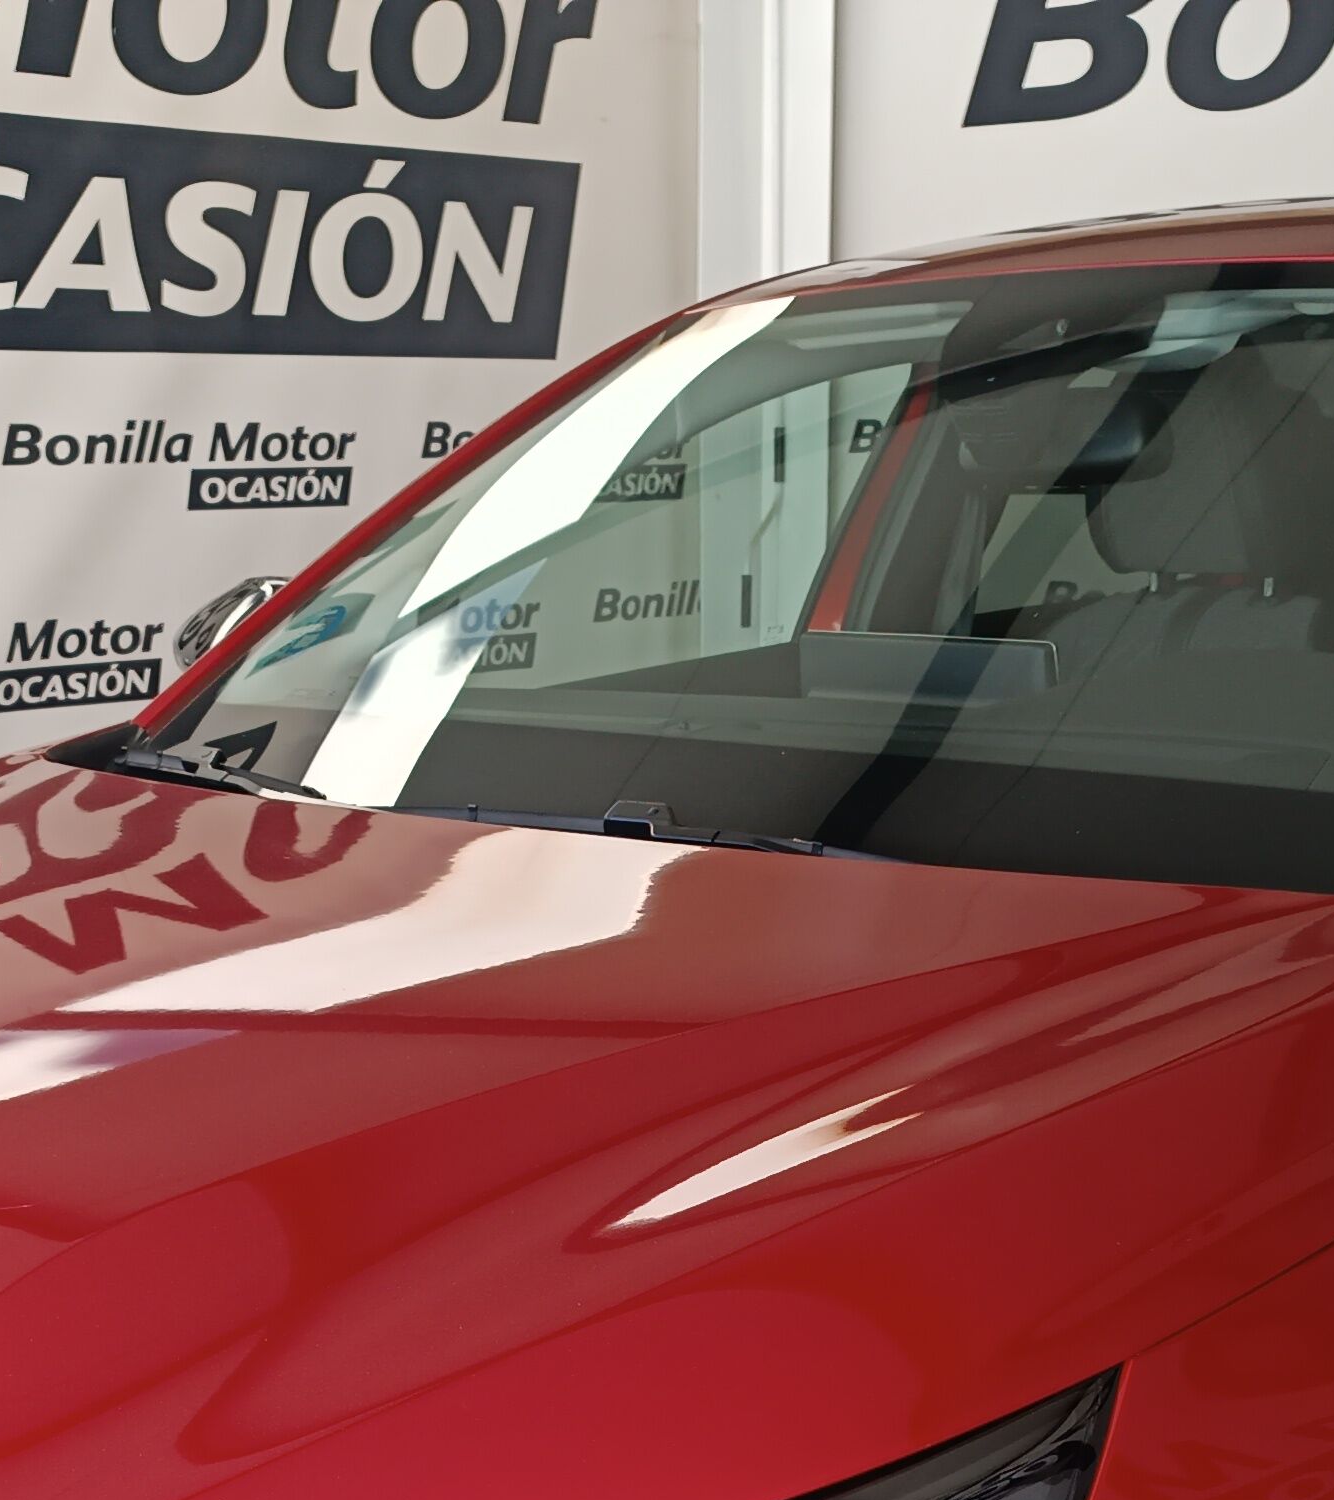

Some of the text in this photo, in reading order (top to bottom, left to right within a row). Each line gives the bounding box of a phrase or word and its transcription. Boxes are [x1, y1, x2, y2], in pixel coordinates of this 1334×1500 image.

[2, 420, 356, 467] Bonilla Motor
[200, 467, 344, 505] OCASIÓN
[593, 579, 700, 623] Bonill
[7, 619, 164, 662] Motor
